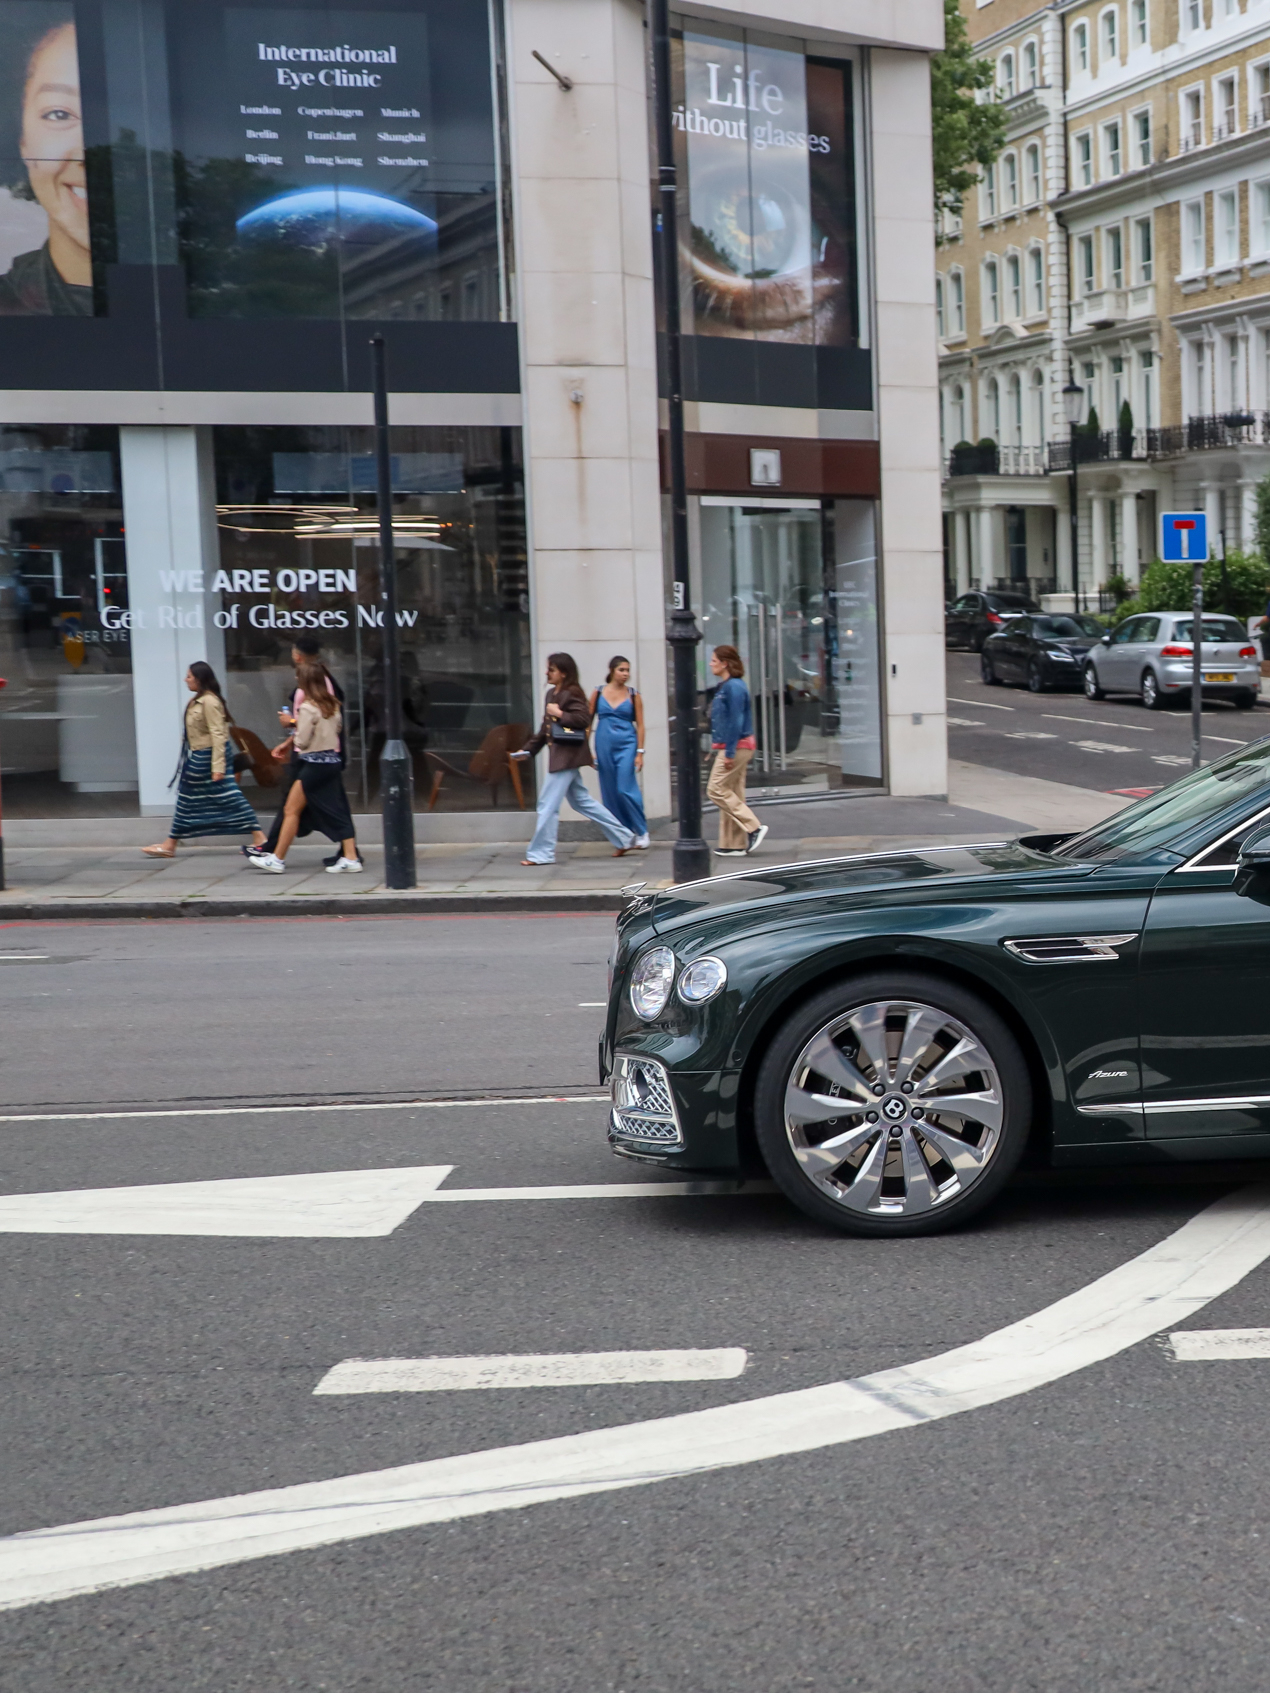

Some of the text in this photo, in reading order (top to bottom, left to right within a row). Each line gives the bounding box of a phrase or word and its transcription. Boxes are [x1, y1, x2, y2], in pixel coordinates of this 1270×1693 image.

[258, 43, 397, 63] International
[277, 68, 381, 90] Eye Clinic
[706, 62, 783, 115] Life
[240, 105, 281, 115] London
[297, 106, 364, 118] Copenhagen
[380, 107, 420, 118] Munich
[246, 129, 279, 139] Berlin
[307, 131, 357, 141] Frankfurt
[377, 132, 426, 144] Shanghai
[752, 121, 831, 153] glasses
[245, 154, 283, 165] Beijing
[305, 155, 335, 167] Hong
[158, 569, 357, 593] WE ARE OPEN
[100, 606, 146, 629] Get
[158, 604, 204, 629] Rid
[213, 604, 241, 629] of
[248, 604, 350, 629] Glasses
[103, 630, 128, 642] EYE
[1088, 1070, 1128, 1079] Azure
